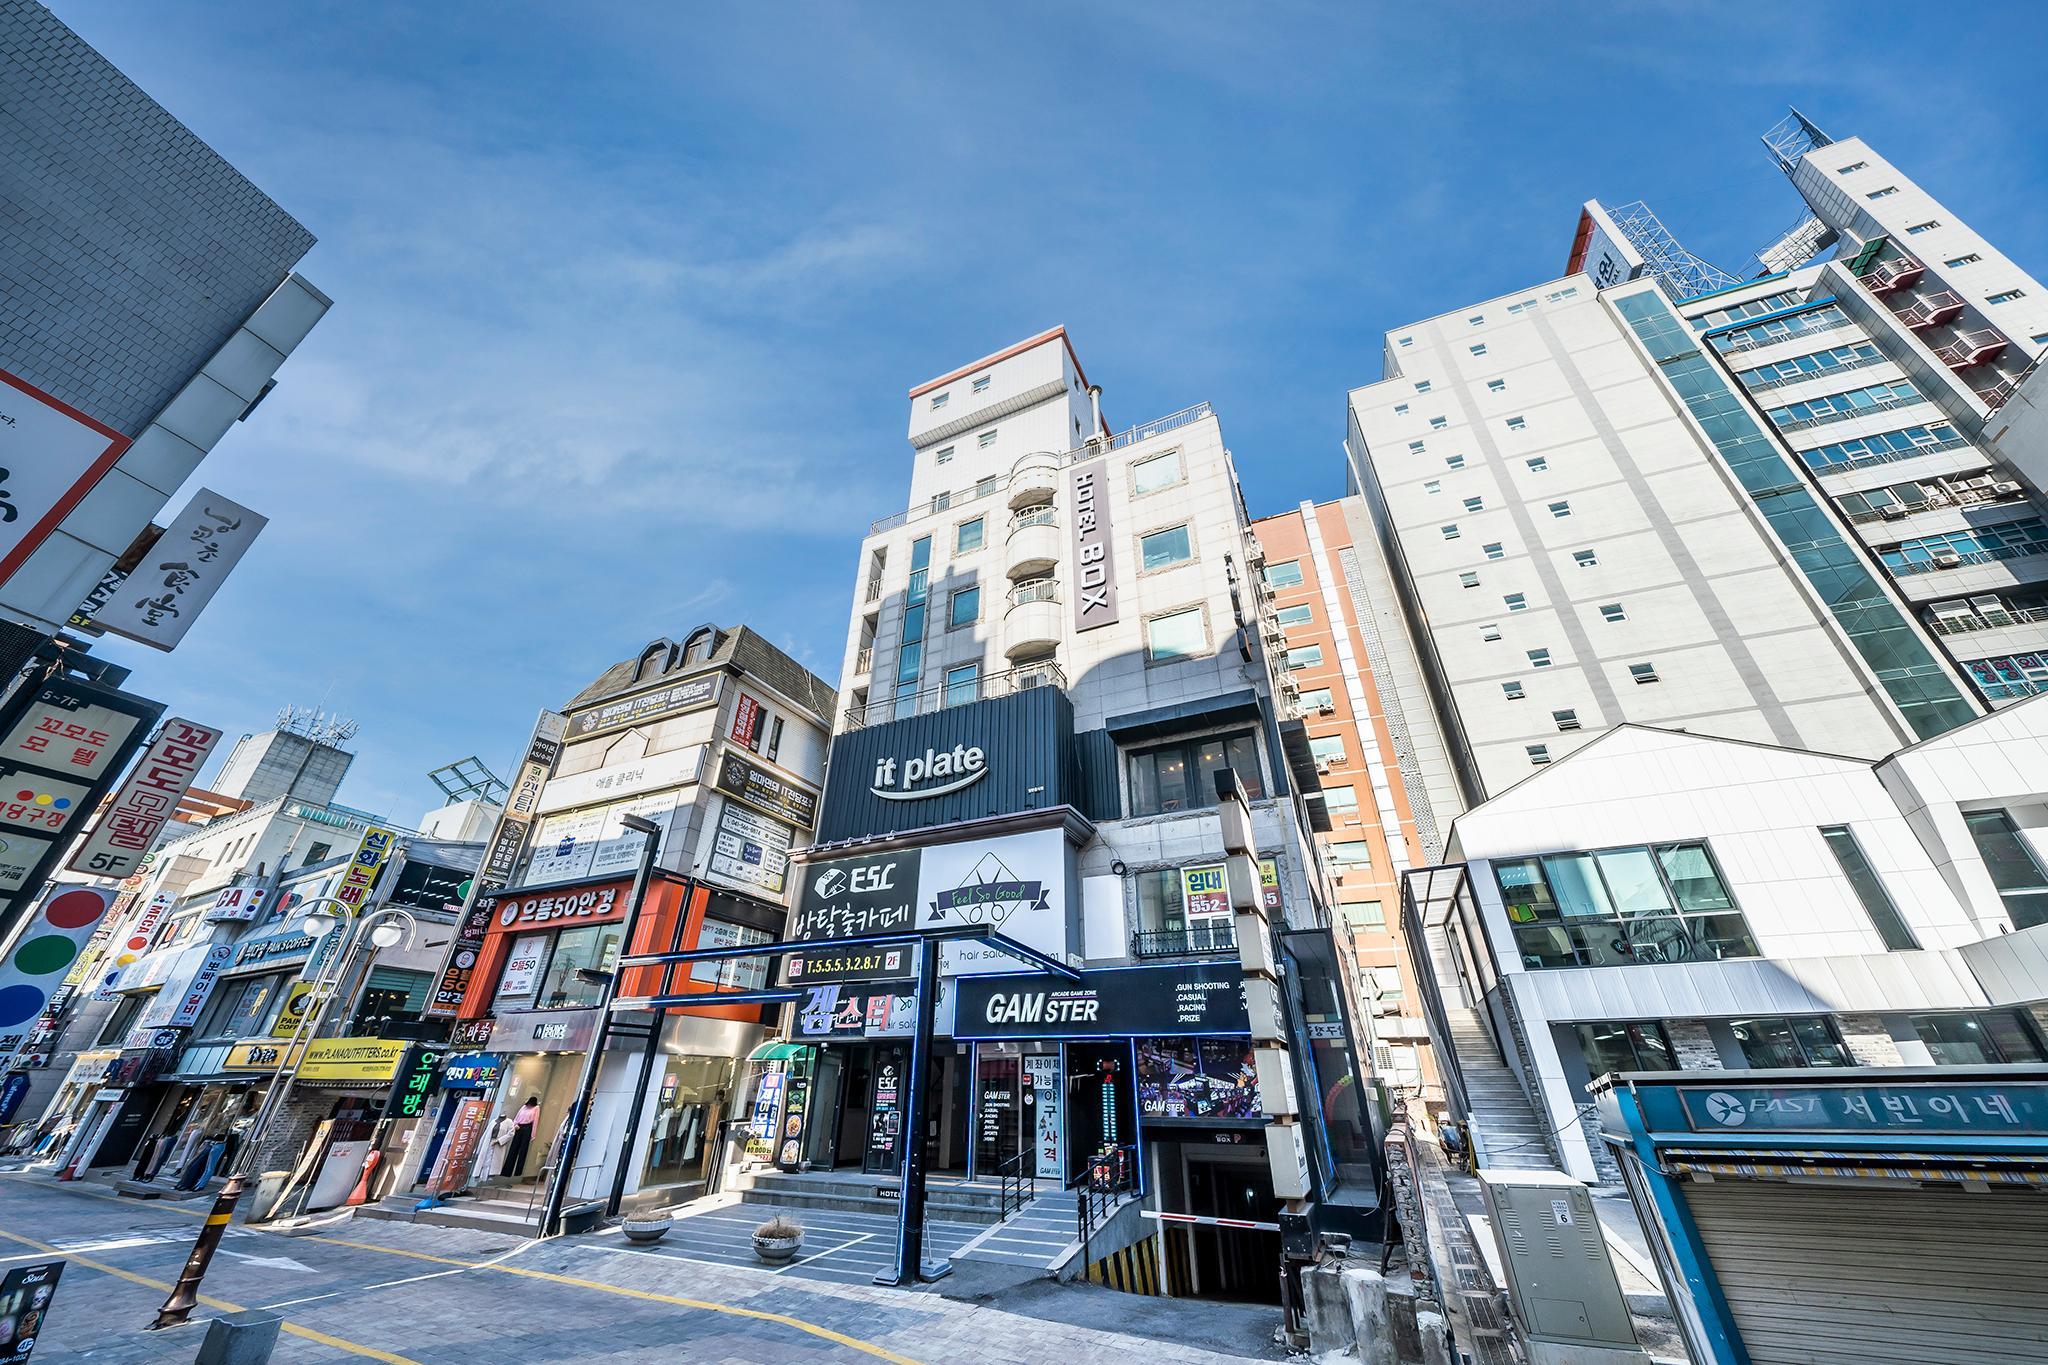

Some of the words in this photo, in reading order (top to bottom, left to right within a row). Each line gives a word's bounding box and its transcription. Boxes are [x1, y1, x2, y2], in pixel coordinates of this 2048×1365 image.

[1076, 472, 1097, 542] HOTEL
[1080, 541, 1109, 616] BOX
[42, 690, 80, 707] 5~7F
[34, 716, 110, 748] 꼬모도
[873, 757, 897, 788] it
[902, 743, 987, 790] plate
[615, 768, 645, 787] 클리닉
[88, 852, 130, 872] 5F
[850, 861, 898, 894] ESC
[1188, 870, 1223, 892] 임대
[951, 889, 973, 905] Feel
[976, 886, 990, 902] So
[994, 884, 1026, 901] Good
[1191, 900, 1227, 913] 552-
[792, 901, 910, 941] 방탈출카페
[887, 955, 898, 966] 2F
[959, 949, 980, 960] hair
[1193, 981, 1230, 991] SHOOTING
[403, 1052, 435, 1115] 오래방
[878, 1076, 898, 1090] ESC
[1035, 1074, 1052, 1086] 가능
[1749, 1097, 1822, 1113] FAST
[1841, 1094, 2021, 1125] 서빈이네
[1560, 1213, 1569, 1224] 6
